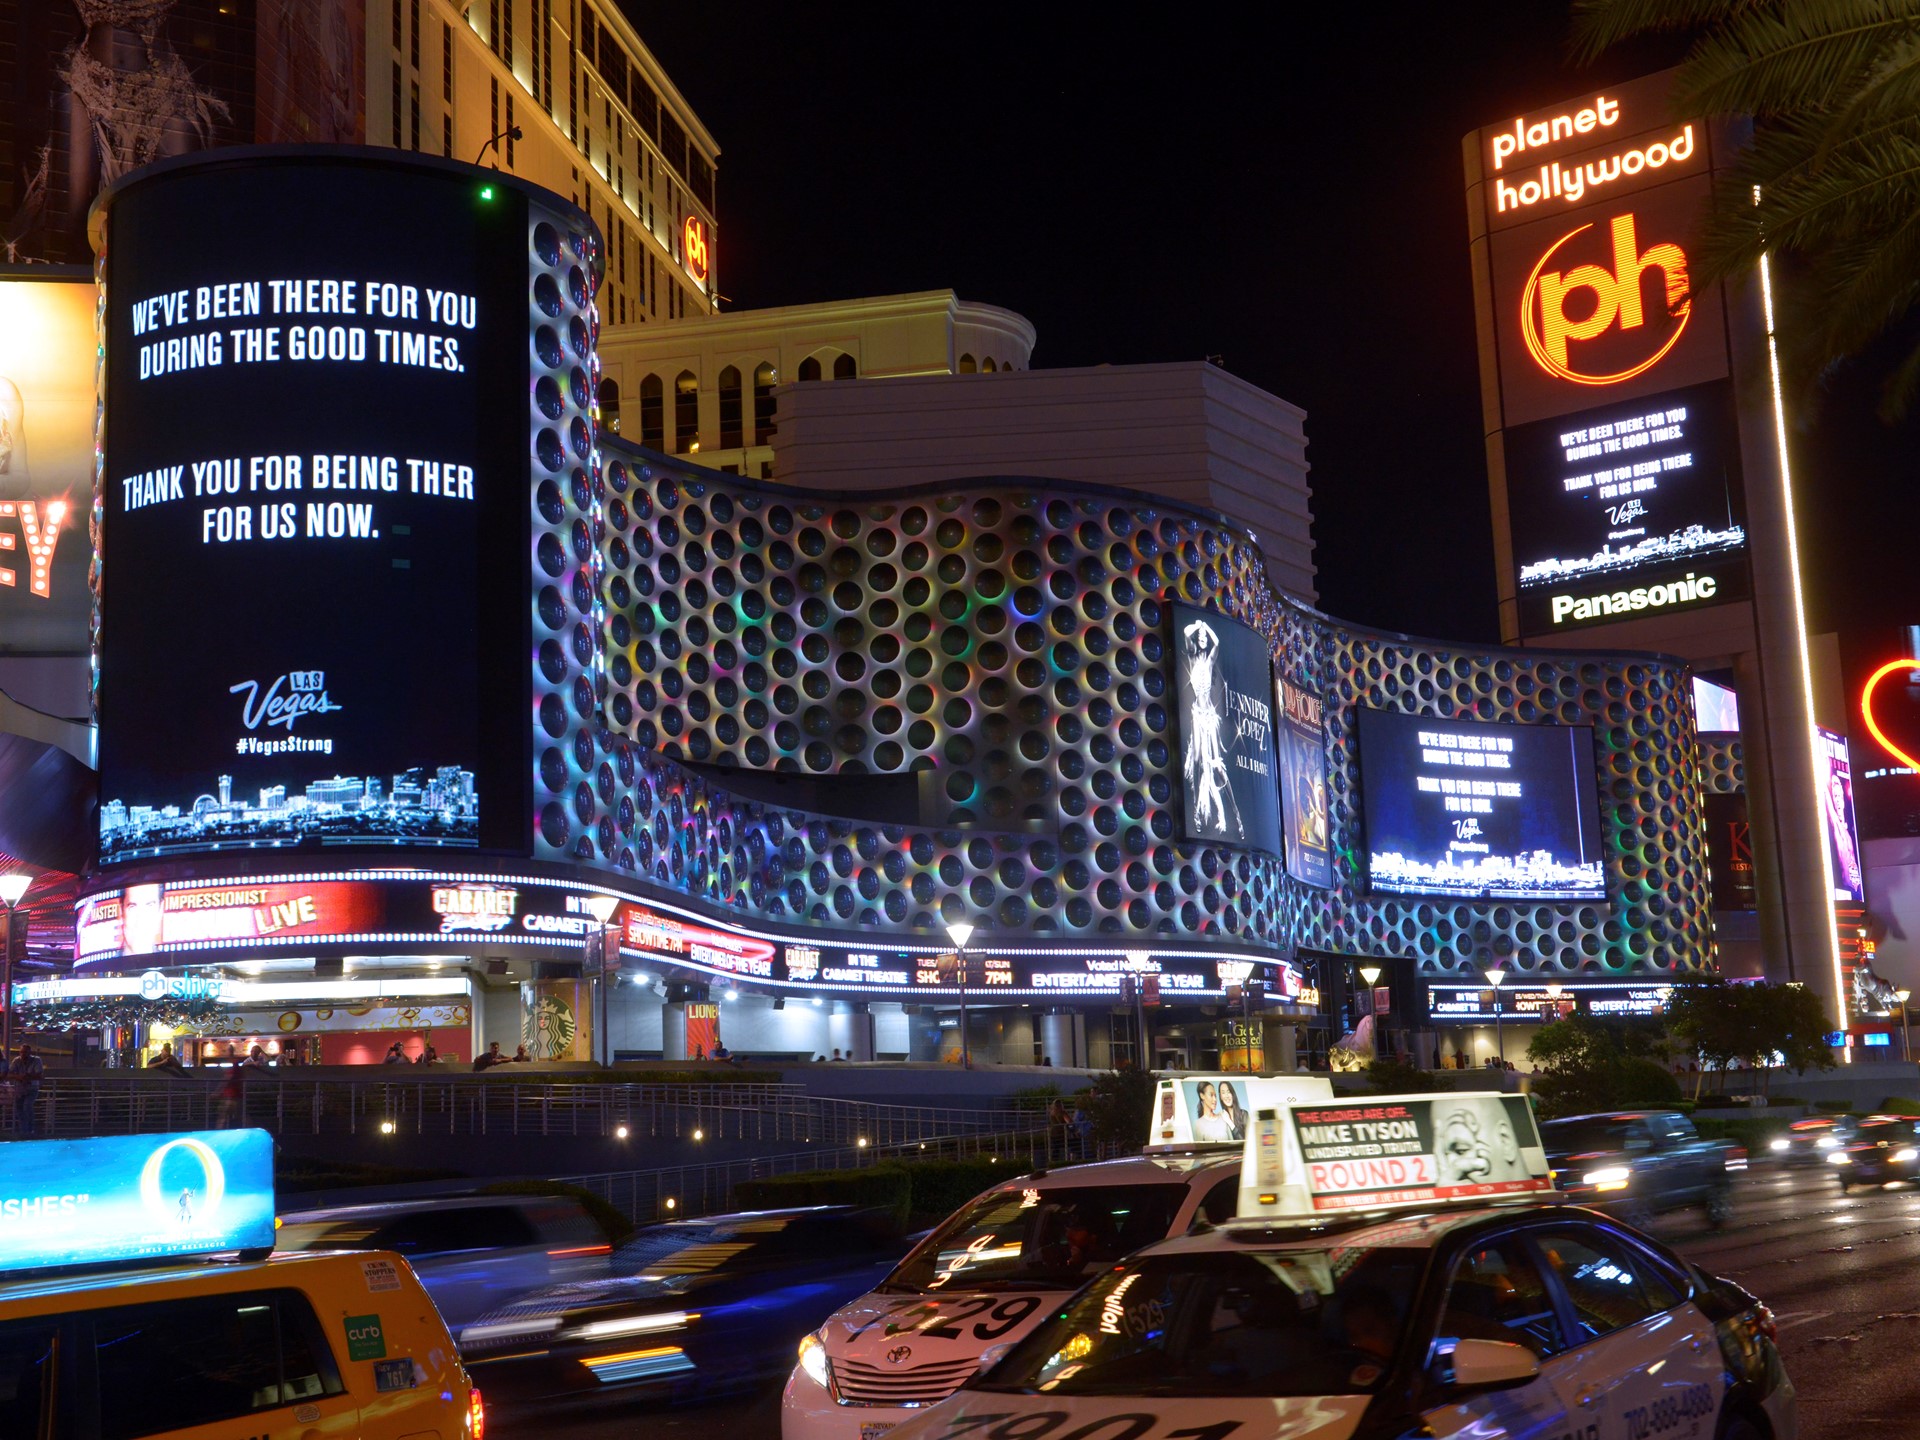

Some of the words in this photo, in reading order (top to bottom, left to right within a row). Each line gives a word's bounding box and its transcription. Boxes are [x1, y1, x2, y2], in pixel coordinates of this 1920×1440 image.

[1493, 96, 1619, 170] planet
[1496, 125, 1694, 213] hollywood
[1538, 212, 1691, 369] ph
[132, 290, 189, 336] WE'VE
[196, 281, 261, 321] BEEN
[268, 280, 357, 314] THERE
[366, 282, 418, 320] FOR
[426, 289, 477, 329] YOU
[140, 331, 223, 380] DURING
[230, 327, 280, 363] THE
[288, 326, 366, 361] GOOD
[374, 329, 465, 373] TIMES.
[1666, 407, 1687, 425] YOU
[123, 465, 184, 511] THANK
[192, 458, 241, 495] YOU
[250, 455, 302, 491] FOR
[312, 455, 398, 491] BEING
[406, 458, 475, 500] THER
[1619, 481, 1631, 495] US
[203, 506, 252, 543] FOR
[261, 503, 296, 539] US
[306, 503, 379, 539] NOW.
[1605, 502, 1648, 525] Vegas
[1552, 572, 1717, 624] Panasonic
[291, 672, 324, 691] LAS
[229, 675, 342, 730] Vegas
[1224, 681, 1271, 732] JENNIFER
[1238, 709, 1266, 750] LOPEZ
[236, 736, 333, 756] #VegasStrong
[1236, 754, 1249, 770] ALL
[1254, 759, 1269, 776] HAVE
[165, 889, 269, 912] IMPRESSIONIST
[254, 895, 317, 936] LIVE
[433, 889, 518, 915] CABARET
[522, 914, 585, 935] CABARET
[785, 949, 820, 968] CABARET
[848, 954, 858, 966] IN
[859, 954, 878, 967] THE
[1086, 960, 1119, 971] Voted
[142, 974, 165, 995] ph
[170, 970, 224, 1000] shiver
[985, 971, 1012, 985] 7PM
[1222, 1034, 1262, 1046] Toased
[1300, 1125, 1353, 1145] MIKE
[1352, 1120, 1419, 1141] TYSON
[1305, 1144, 1382, 1159] UNDISPUTED
[1382, 1141, 1422, 1154] TRUTH
[1311, 1159, 1406, 1191] ROUND
[1412, 1158, 1429, 1182] 2
[182, 1241, 226, 1250] BELLAGIO
[364, 1267, 396, 1277] STOPPERS
[348, 1325, 380, 1340] curb
